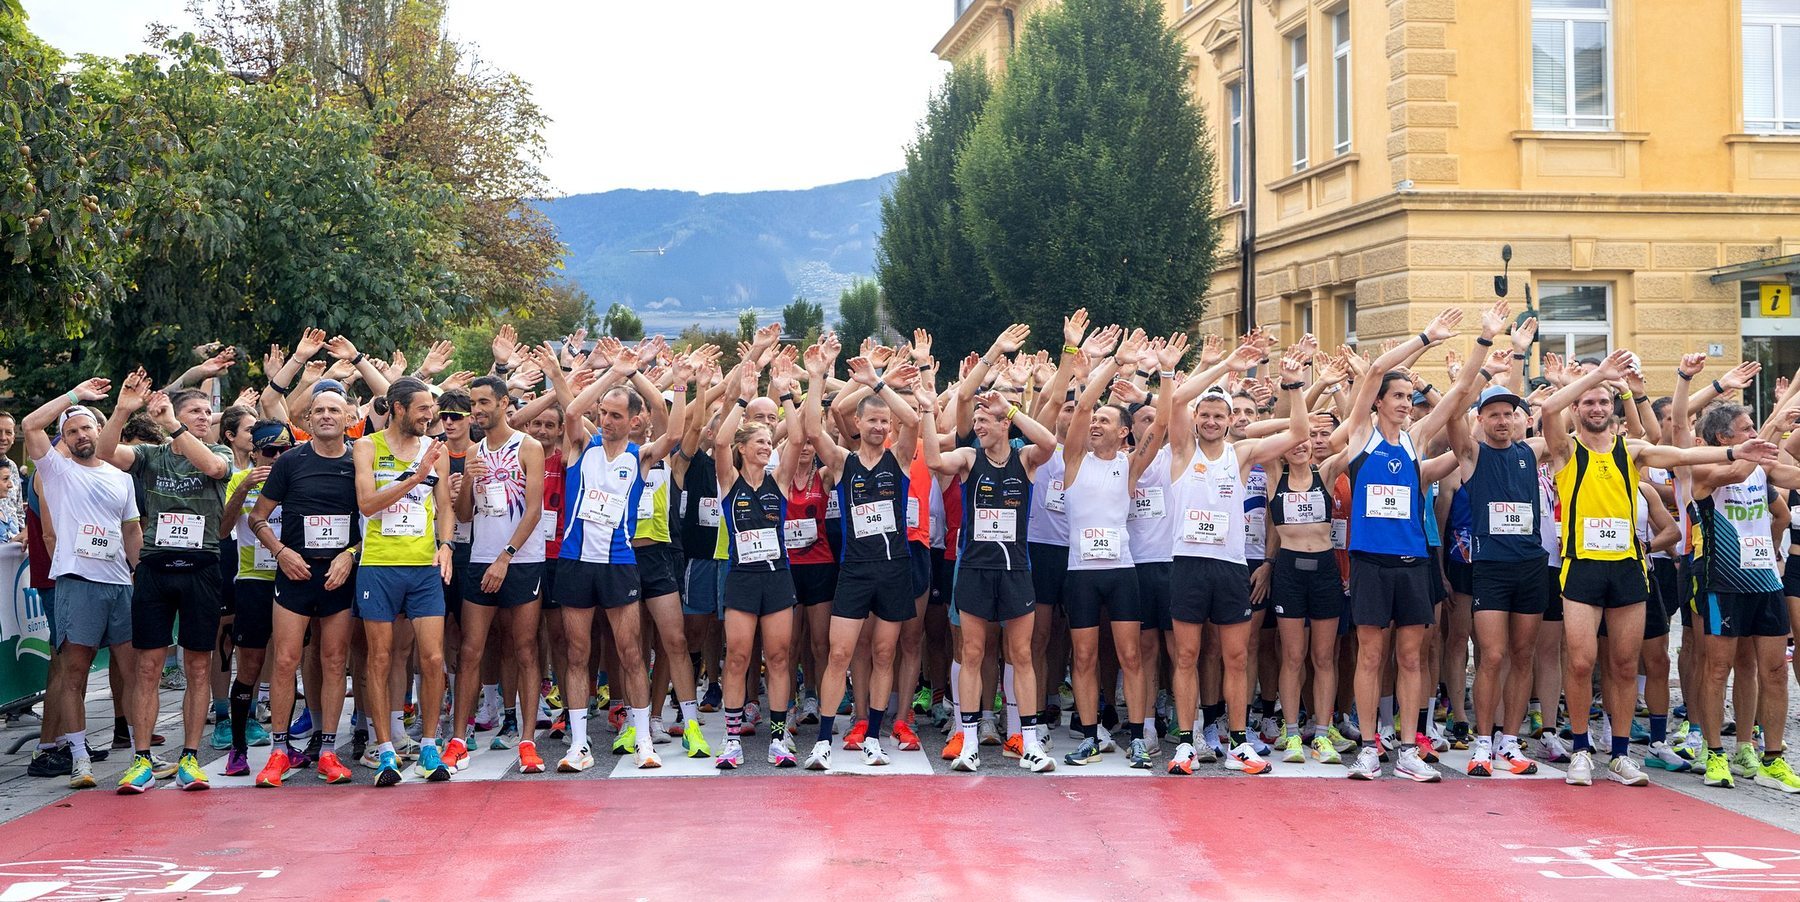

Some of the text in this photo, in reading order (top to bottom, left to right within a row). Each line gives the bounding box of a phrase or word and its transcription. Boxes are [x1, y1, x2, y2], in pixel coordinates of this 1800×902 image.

[1053, 481, 1063, 490] O
[1373, 485, 1394, 495] ON
[589, 490, 609, 503] ON
[1287, 493, 1308, 503] ON
[1136, 499, 1151, 508] 542
[1385, 497, 1396, 506] 99
[855, 504, 876, 515] ON
[1297, 504, 1312, 512] 355
[1495, 503, 1515, 512] ON
[163, 513, 184, 525] ON
[866, 514, 882, 524] 346
[978, 510, 999, 519] ON
[1189, 510, 1210, 521] ON
[1505, 514, 1520, 522] 188
[309, 516, 331, 526] ON
[402, 515, 408, 524] 2
[1590, 519, 1612, 528] ON
[992, 521, 998, 529] 6
[1198, 522, 1214, 531] 329
[83, 524, 106, 536] ON
[170, 526, 188, 535] 219
[322, 528, 333, 536] 21
[1084, 529, 1104, 538] ON
[1332, 530, 1336, 538] 2
[1599, 530, 1616, 539] 342
[741, 531, 760, 542] ON
[91, 537, 108, 547] 899
[753, 541, 762, 549] 11
[1093, 539, 1109, 547] 243
[1744, 537, 1764, 547] ON
[1754, 548, 1768, 557] 249
